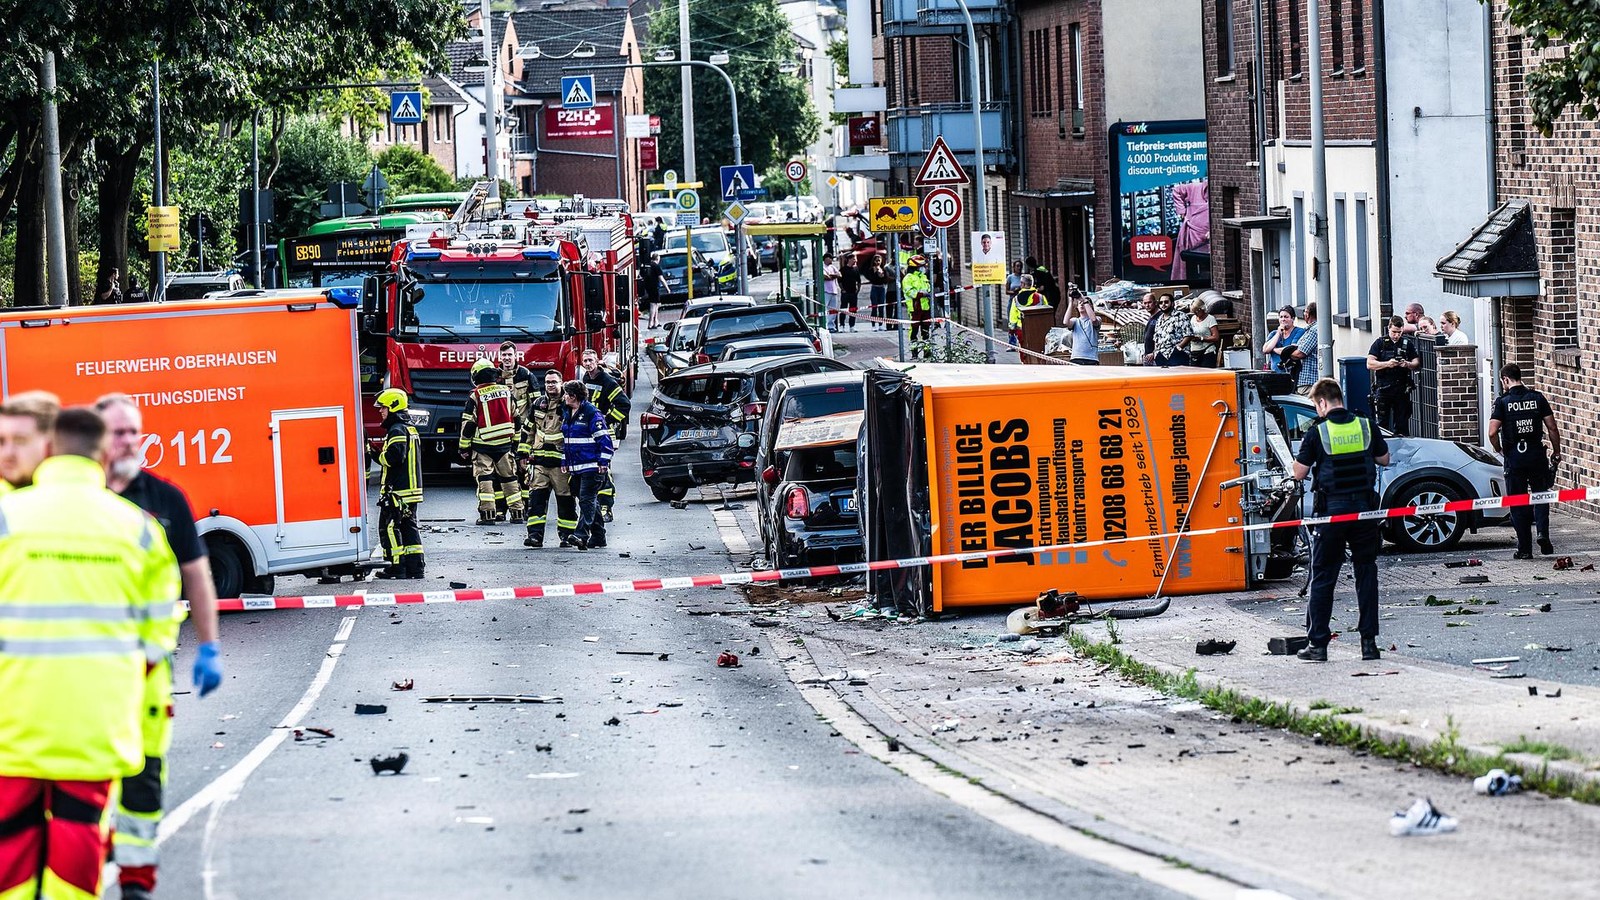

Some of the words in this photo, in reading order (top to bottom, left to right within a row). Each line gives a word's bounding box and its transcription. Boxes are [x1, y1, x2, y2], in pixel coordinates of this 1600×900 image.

[558, 110, 583, 122] PZH
[1127, 154, 1152, 164] 4.000
[1154, 152, 1191, 162] Produkte
[1128, 164, 1200, 176] discount-günstig.
[790, 166, 802, 176] 50
[932, 200, 954, 217] 30
[296, 244, 321, 261] SB90
[342, 240, 391, 248] MH-Styrum
[1136, 242, 1166, 251] REWE
[76, 356, 170, 376] FEUERWEHR
[174, 350, 277, 370] OBERHAUSEN
[1098, 408, 1122, 429] 21
[1124, 396, 1140, 438] 1989
[1508, 400, 1537, 412] POLIZEI
[170, 428, 232, 466] 112
[1100, 435, 1123, 460] 68
[1333, 434, 1360, 445] POLIZEI
[1132, 440, 1147, 468] seit
[956, 423, 986, 515] BILLIGE
[1053, 418, 1069, 545] Haushaltsauflösung
[1101, 464, 1125, 489] 68
[988, 418, 1034, 566] JACOBS
[1037, 456, 1052, 547] Entrümpelung
[1070, 440, 1087, 544] Kleintransporte
[1103, 494, 1127, 543] 0208
[1138, 473, 1164, 578] Familienbetrieb
[960, 522, 988, 569] DER
[840, 564, 868, 572] POLIZEI
